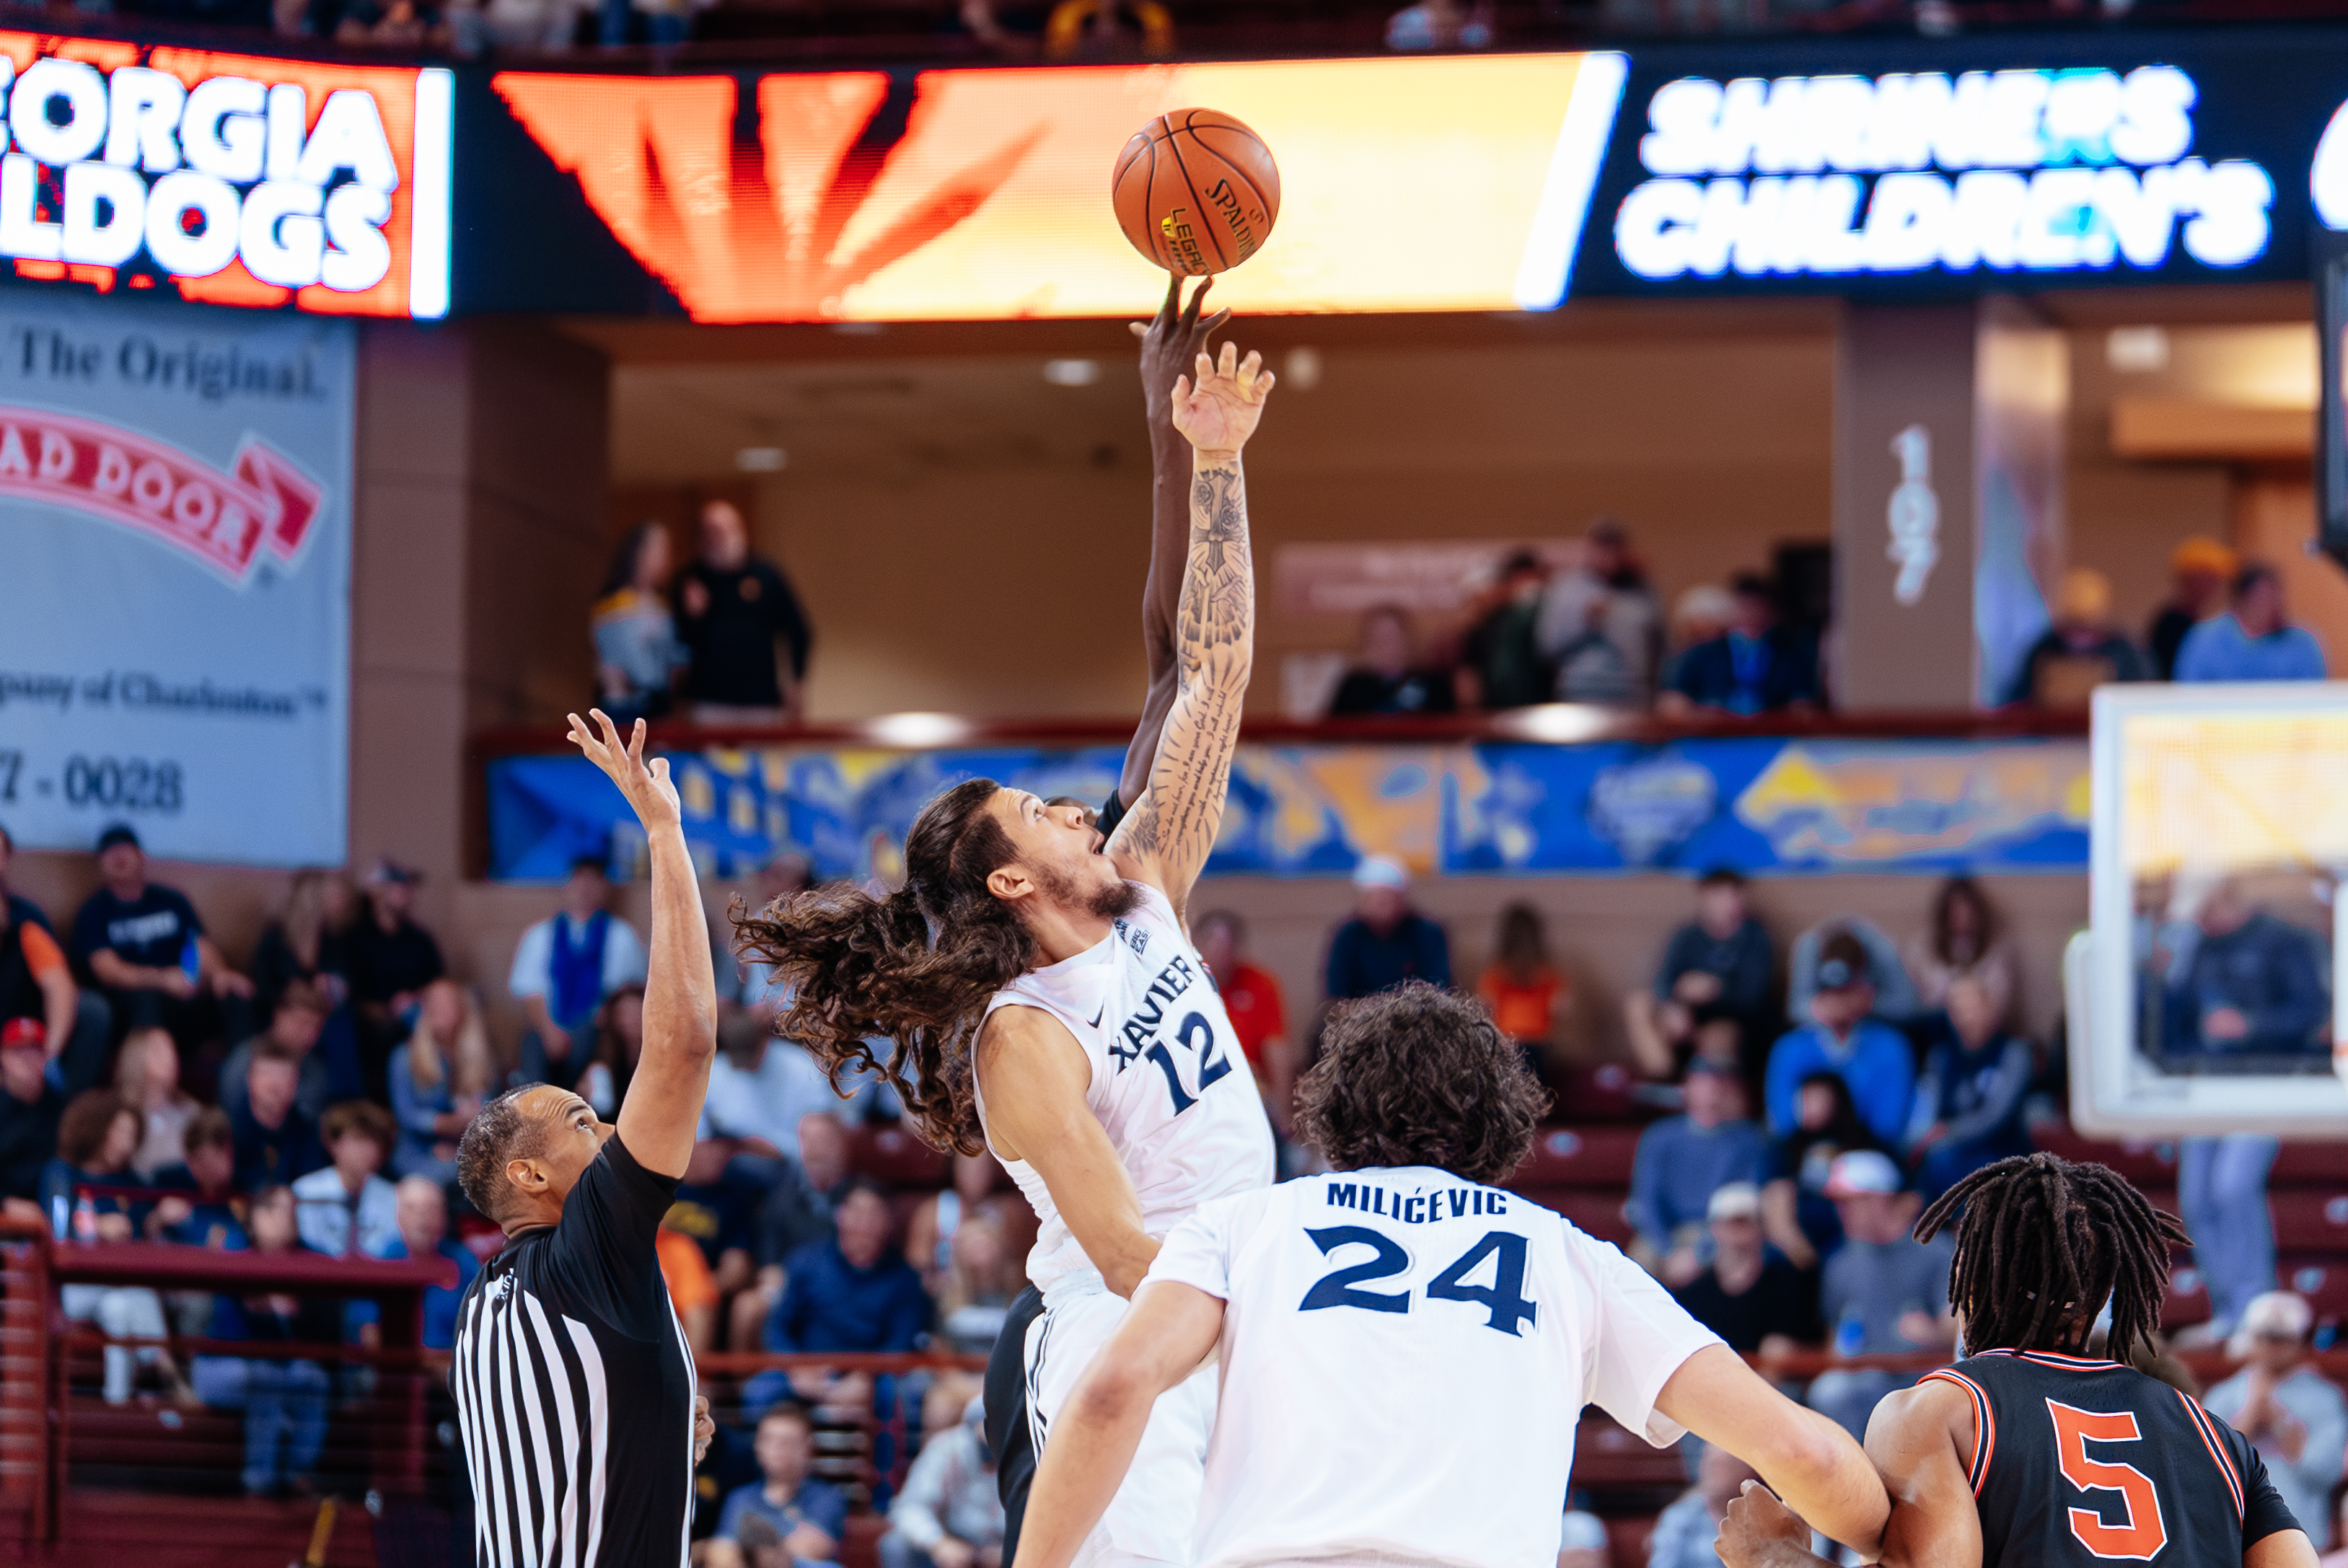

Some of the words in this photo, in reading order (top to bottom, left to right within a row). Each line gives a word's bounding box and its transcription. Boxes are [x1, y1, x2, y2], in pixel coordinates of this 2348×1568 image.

[0, 55, 400, 193] ORGIA
[1638, 63, 2198, 175] SHRINERS
[1204, 177, 1257, 260] SPALDIN
[1613, 156, 2276, 279] CHILDREN'S
[10, 325, 102, 382] The
[94, 442, 249, 553] DOOR
[1887, 425, 1938, 604] 107
[64, 753, 184, 813] 0028
[1129, 928, 1141, 949] BIG
[1107, 954, 1196, 1076] XAVIER
[1144, 1010, 1233, 1116] 12
[1298, 1225, 1538, 1338] 24
[2044, 1396, 2168, 1561] 5
